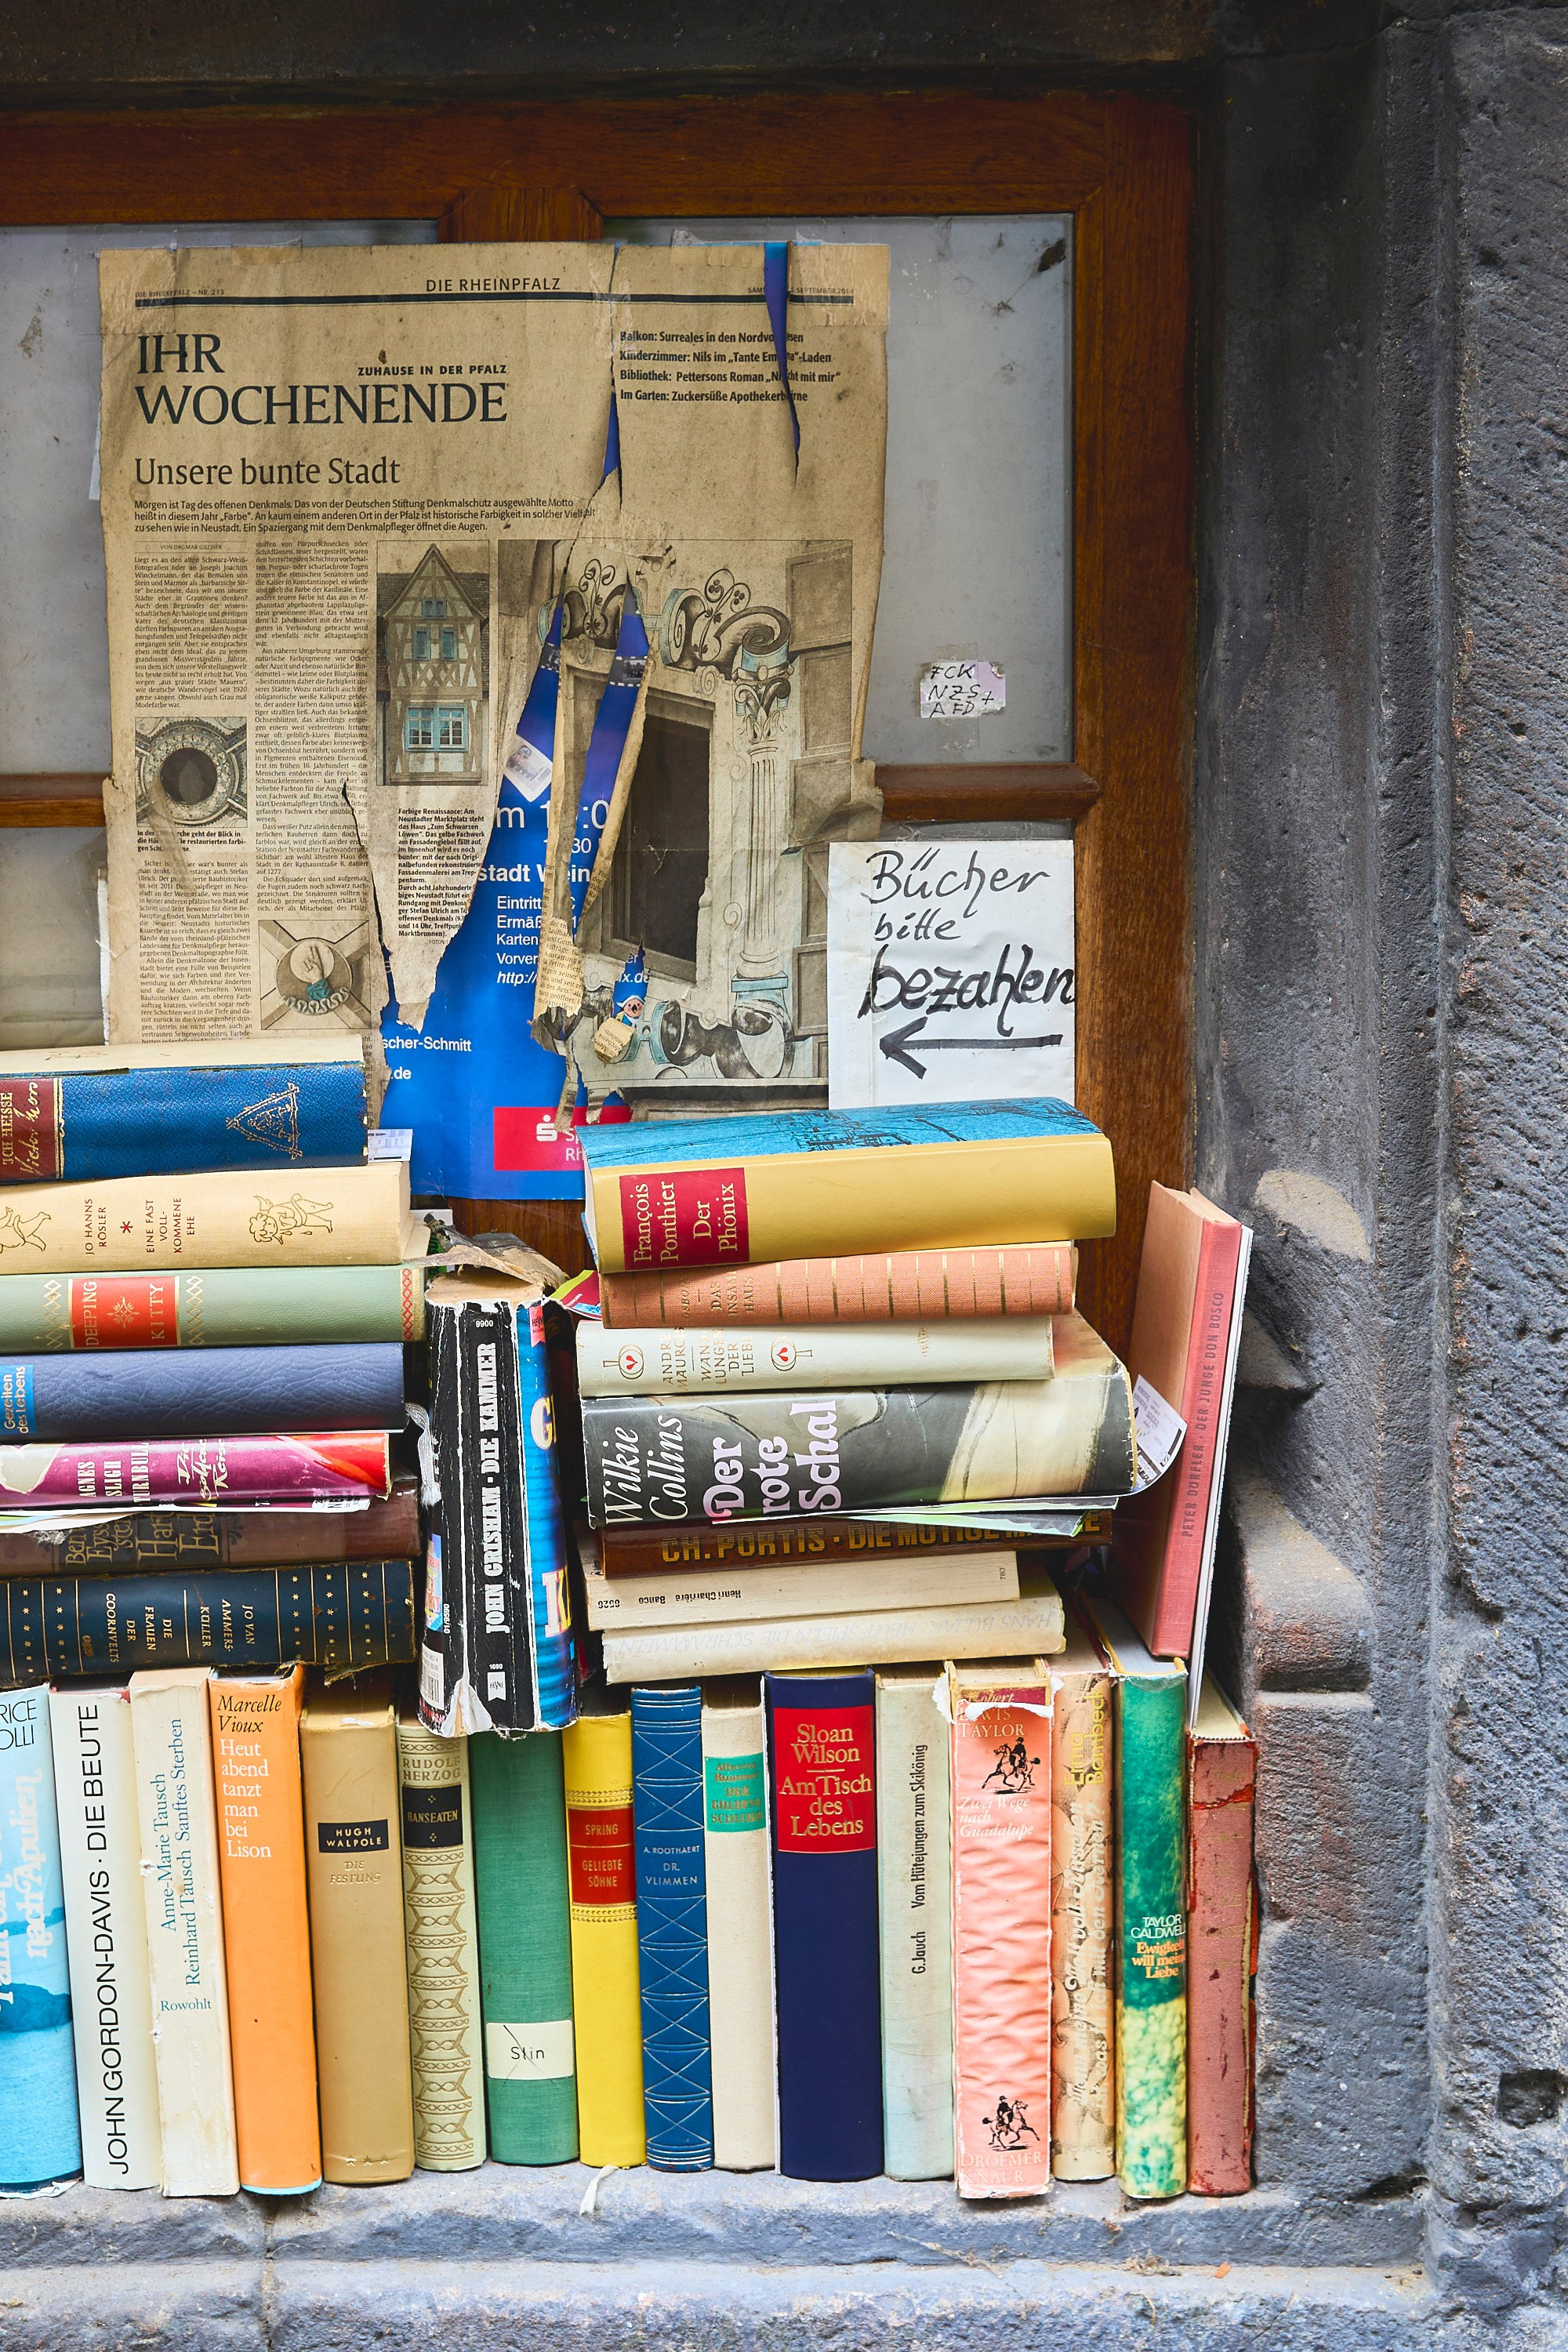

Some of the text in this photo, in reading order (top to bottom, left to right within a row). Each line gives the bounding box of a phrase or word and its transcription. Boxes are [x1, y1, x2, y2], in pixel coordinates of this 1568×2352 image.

[426, 277, 561, 292] DIE RHEINPFALZ
[620, 331, 735, 343] Balkon: Surreales in den
[137, 333, 225, 374] IHR
[620, 350, 725, 363] Kinderzimmer: Nils im
[358, 364, 507, 376] ZUHAUSE IN DER PFALZ
[620, 370, 816, 383] Bibliothek: Pettersons Roman mit
[135, 383, 508, 425] WOCHENENDE
[620, 390, 727, 402] Im Garten: Zuckersüße
[135, 456, 401, 485] Unsere bunte Stadt
[135, 500, 168, 511] Morgen
[181, 500, 196, 511] Tag
[198, 500, 213, 509] des
[214, 500, 247, 510] offenen
[249, 500, 292, 510] Denkmals.
[295, 500, 310, 509] Das
[329, 499, 344, 509] der
[346, 499, 390, 509] Deutschen
[392, 499, 425, 510] Stiftung
[426, 499, 492, 508] Denkmalschutz
[493, 498, 546, 510] ausgewählte
[549, 499, 574, 507] Motto
[931, 663, 975, 680] FCK
[860, 848, 1051, 918] Bücher
[874, 908, 961, 942] bitte
[858, 943, 1075, 1036] bezahlen
[98, 1207, 107, 1247] RÖSLER
[630, 1183, 653, 1262] François
[657, 1181, 679, 1261] Ponthier
[693, 1200, 712, 1239] Der
[716, 1183, 737, 1252] Phönix
[85, 1242, 95, 1254] JO
[146, 1229, 154, 1253] EINE
[84, 1280, 99, 1345] DEEPING
[150, 1283, 164, 1340] KITTY
[1209, 1293, 1224, 1328] BOSCO
[475, 1319, 494, 1328] 9900
[1204, 1335, 1218, 1358] DON
[1199, 1365, 1214, 1403] JUNGE
[2, 1374, 15, 1429] Gezeiten
[14, 1366, 28, 1434] des Lebens
[1196, 1409, 1209, 1430] DER
[789, 1400, 841, 1509] Schal
[131, 1442, 151, 1503] TURNBULL
[602, 1426, 643, 1524] Wilkie
[647, 1414, 688, 1520] Collins
[750, 1436, 790, 1514] rote
[78, 1461, 96, 1497] AGNES
[103, 1461, 122, 1497] SLIGH
[477, 1342, 510, 1634] JOHN GRISHAM DIE KAMMER
[703, 1436, 744, 1523] Der
[1182, 1503, 1197, 1537] PETER
[662, 1521, 891, 1563] CH. PORTIS DIE
[639, 1595, 666, 1604] Banco
[718, 1589, 741, 1599] Henri
[106, 1593, 119, 1663] COORNVELTS
[127, 1620, 136, 1641] DER
[144, 1606, 156, 1650] FRAUEN
[162, 1618, 172, 1639] DIE
[245, 1623, 255, 1644] VAN
[217, 1695, 282, 1713] Marcelle
[220, 1715, 263, 1733] Vioux
[797, 1723, 855, 1745] Sloan
[958, 1722, 1025, 1738] TAYLOR
[1084, 1686, 1105, 1784] Bombeck
[220, 1739, 261, 1758] Heut
[791, 1743, 861, 1764] Wilson
[1064, 1733, 1084, 1785] Erma
[221, 1759, 269, 1777] abend
[402, 1755, 460, 1769] RUDOLF
[403, 1768, 460, 1781] HERZOG
[779, 1773, 873, 1797] Am Tisch
[223, 1780, 262, 1798] tanzt
[224, 1804, 259, 1818] man
[809, 1797, 843, 1817] des
[959, 1796, 1029, 1813] Zwei Wege
[408, 1809, 458, 1824] HANSEATEN
[790, 1816, 863, 1838] Lebens
[910, 1744, 927, 1909] Vom Hütejungen zum Skikönig
[960, 1810, 991, 1824] nach
[225, 1820, 248, 1838] bei
[336, 1827, 372, 1838] HUGH
[585, 1823, 618, 1836] SPRING
[960, 1823, 1033, 1841] Guadalupe
[169, 1719, 200, 1985] Reinhard Tausch Sanftes Sterben
[226, 1840, 272, 1859] Lison
[326, 1835, 382, 1848] WALPOLE
[652, 1844, 700, 1855] ROOTHAERT
[150, 1773, 176, 1932] Anne-Marie Tausch
[343, 1859, 365, 1871] DIE
[582, 1859, 622, 1872] GELIEBTE
[662, 1861, 681, 1872] DR.
[588, 1872, 618, 1887] SÖHNE
[645, 1875, 699, 1886] VLIMMEN
[27, 1891, 53, 1958] nach
[1142, 1914, 1181, 1928] TAYLOR
[78, 1704, 129, 2174] JOHN GORDON-DAVIS DIE BEUTE
[1132, 1955, 1154, 1966] will
[1145, 1966, 1178, 1979] Liebe
[161, 1998, 212, 2012] Rowohlt
[960, 2151, 1043, 2168] DROEMER
[961, 2169, 1024, 2184] KNAUR
